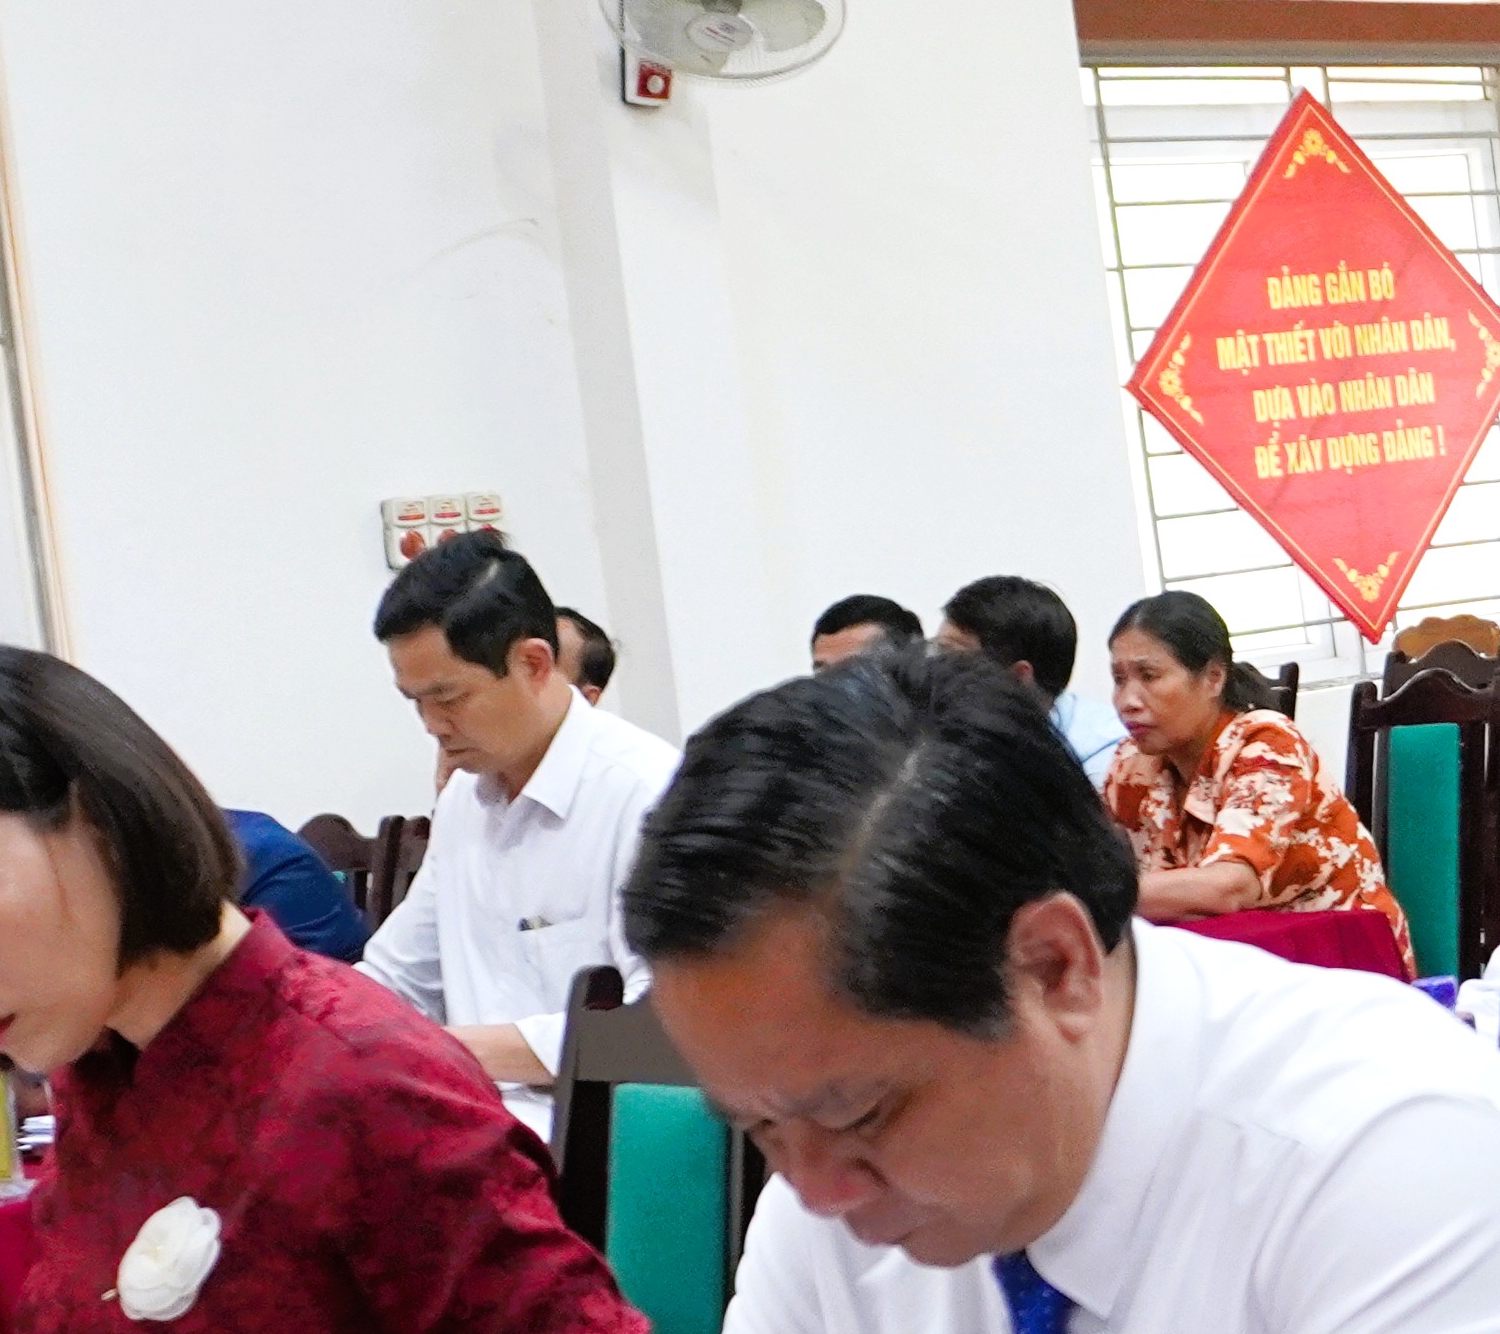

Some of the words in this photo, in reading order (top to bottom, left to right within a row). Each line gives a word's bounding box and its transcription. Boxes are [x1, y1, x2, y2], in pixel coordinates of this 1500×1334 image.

[1267, 265, 1324, 310] ĐẢNG
[1325, 260, 1366, 304] GẮN
[1368, 262, 1395, 301] BÓ
[1216, 329, 1260, 376] MẬT
[1262, 319, 1316, 366] THIẾT
[1354, 315, 1407, 357] NHÂN
[1252, 385, 1296, 428] DỰA
[1297, 378, 1336, 417] VÀO
[1338, 371, 1393, 413] NHÂN
[1395, 367, 1436, 405] DÂN
[1254, 431, 1283, 479] ĐỂ
[1285, 434, 1323, 475] XÂY
[1326, 432, 1381, 475] DỰNG
[1382, 419, 1435, 462] ĐẢNG
